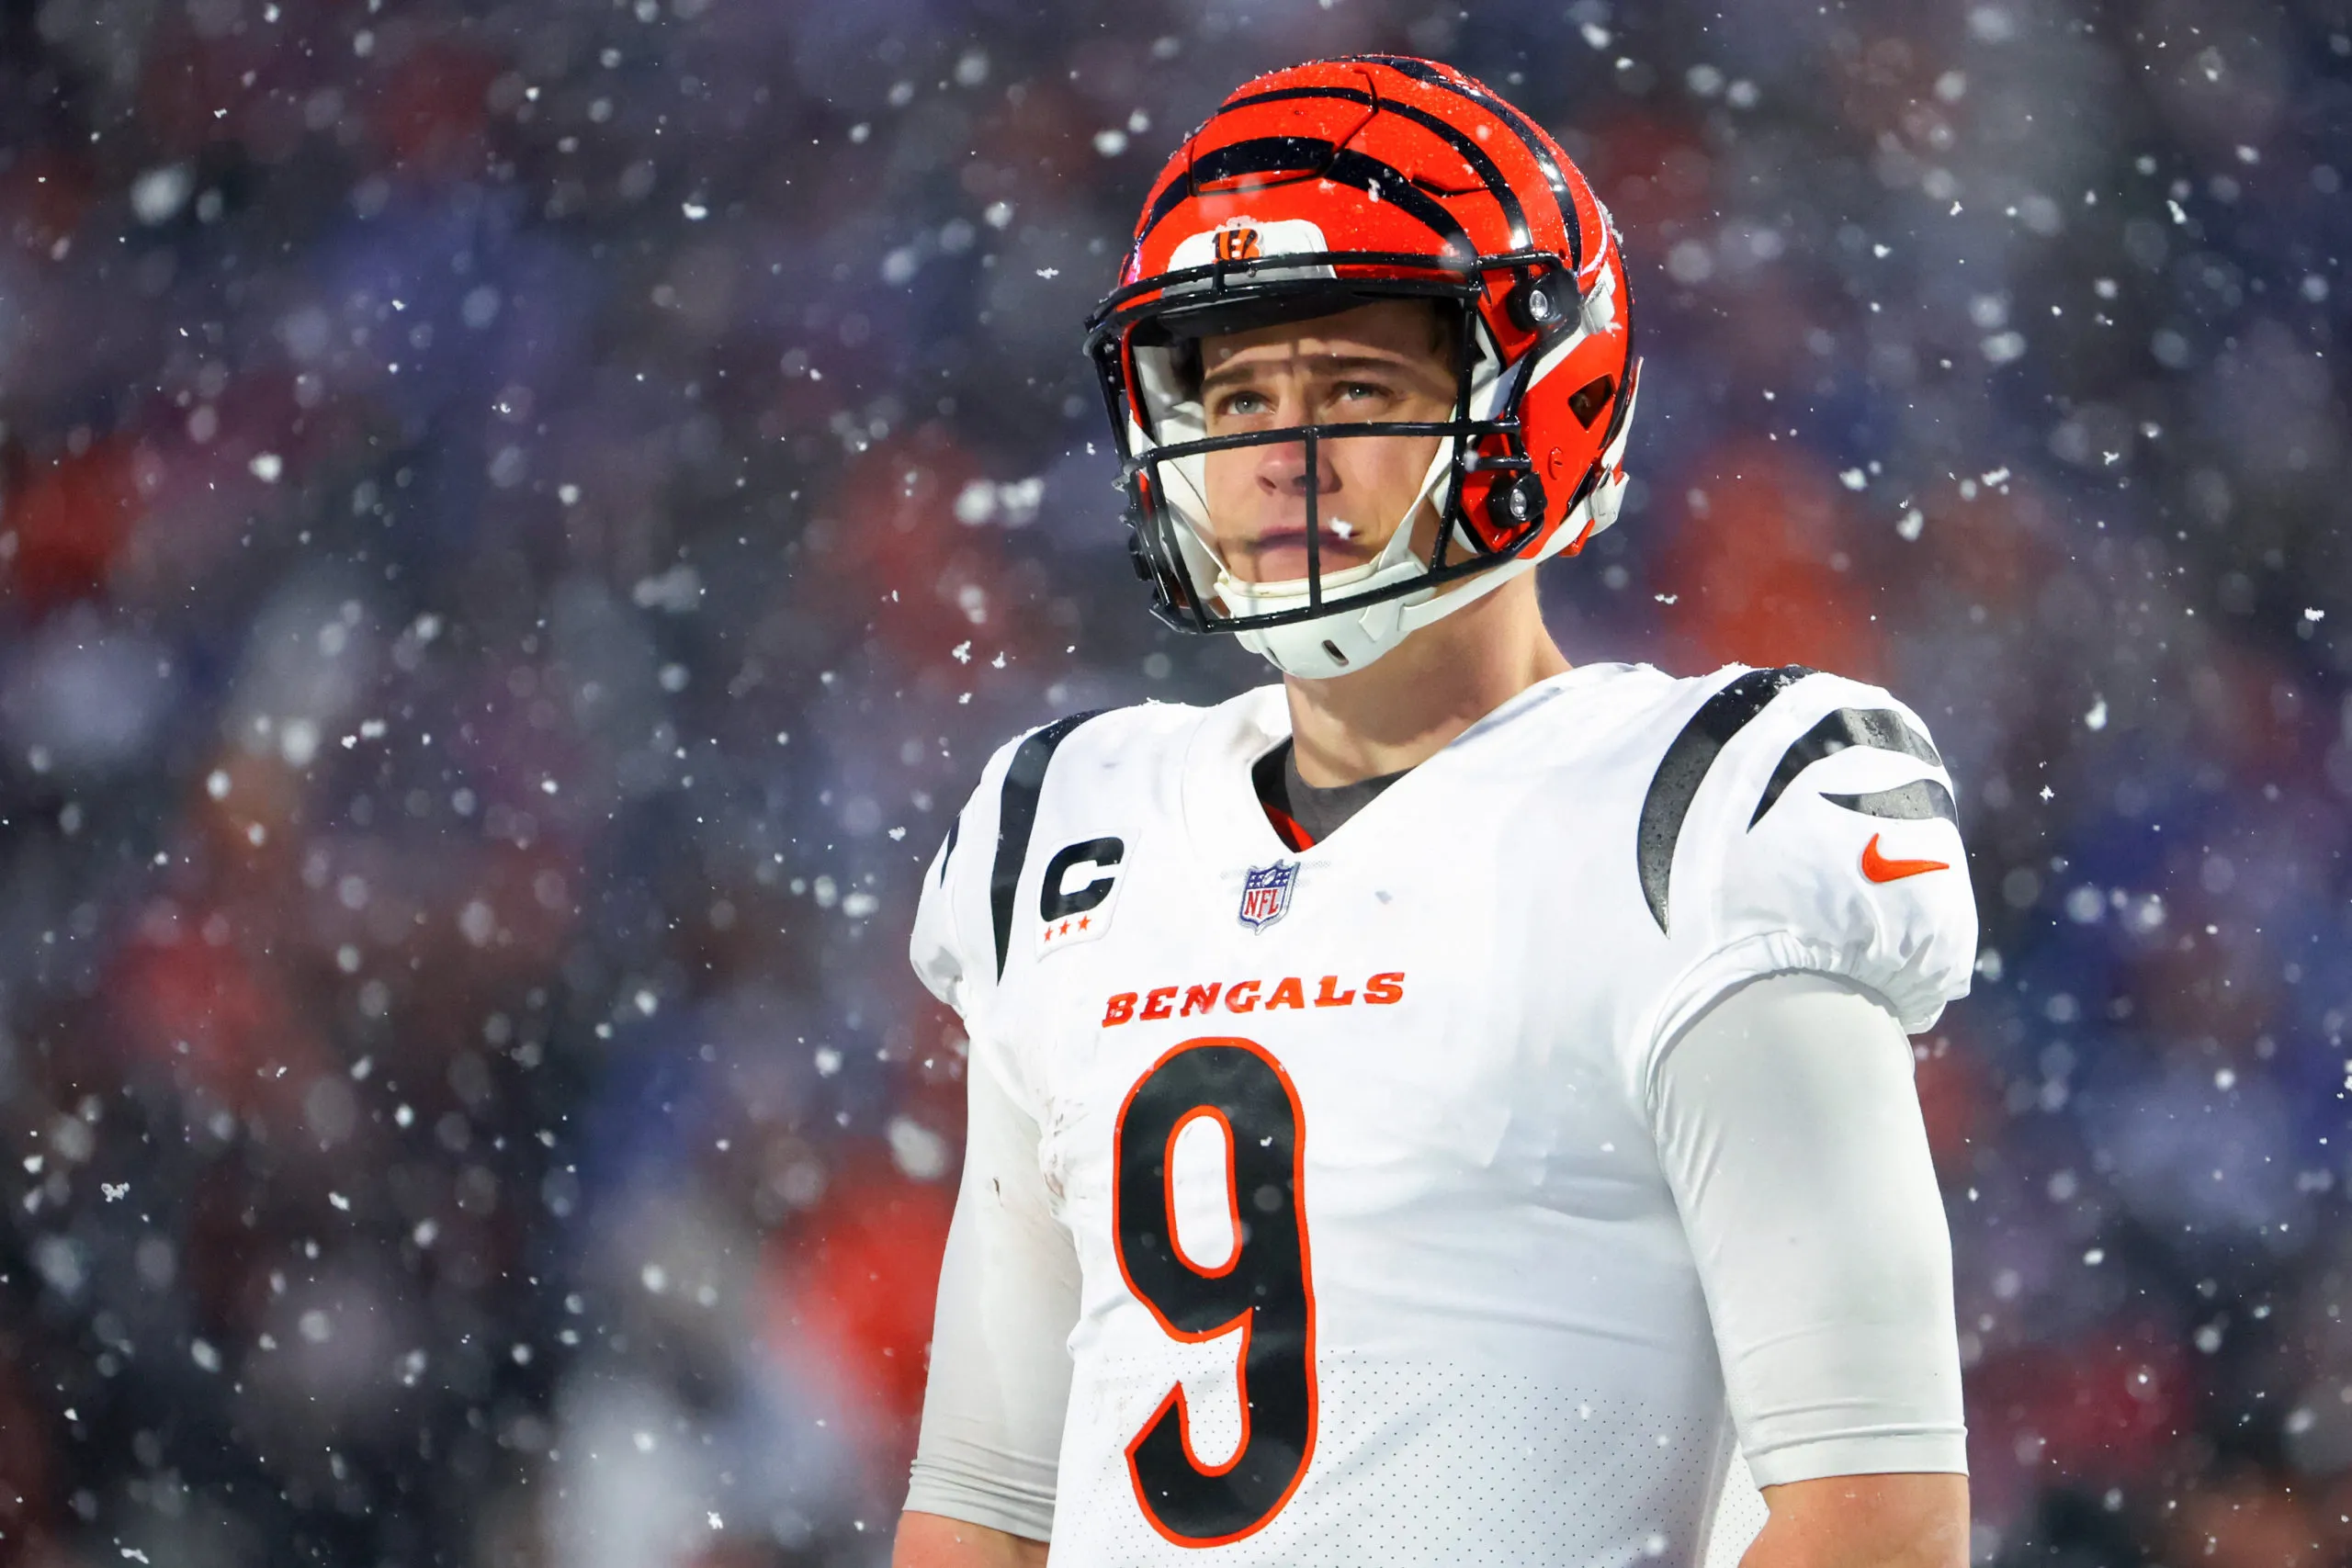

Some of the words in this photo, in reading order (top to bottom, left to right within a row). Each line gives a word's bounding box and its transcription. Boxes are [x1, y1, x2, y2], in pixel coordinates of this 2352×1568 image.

[1040, 837, 1125, 922] C
[1244, 888, 1279, 919] NFL
[1102, 972, 1406, 1028] BENGALS
[1113, 1036, 1317, 1549] 9
